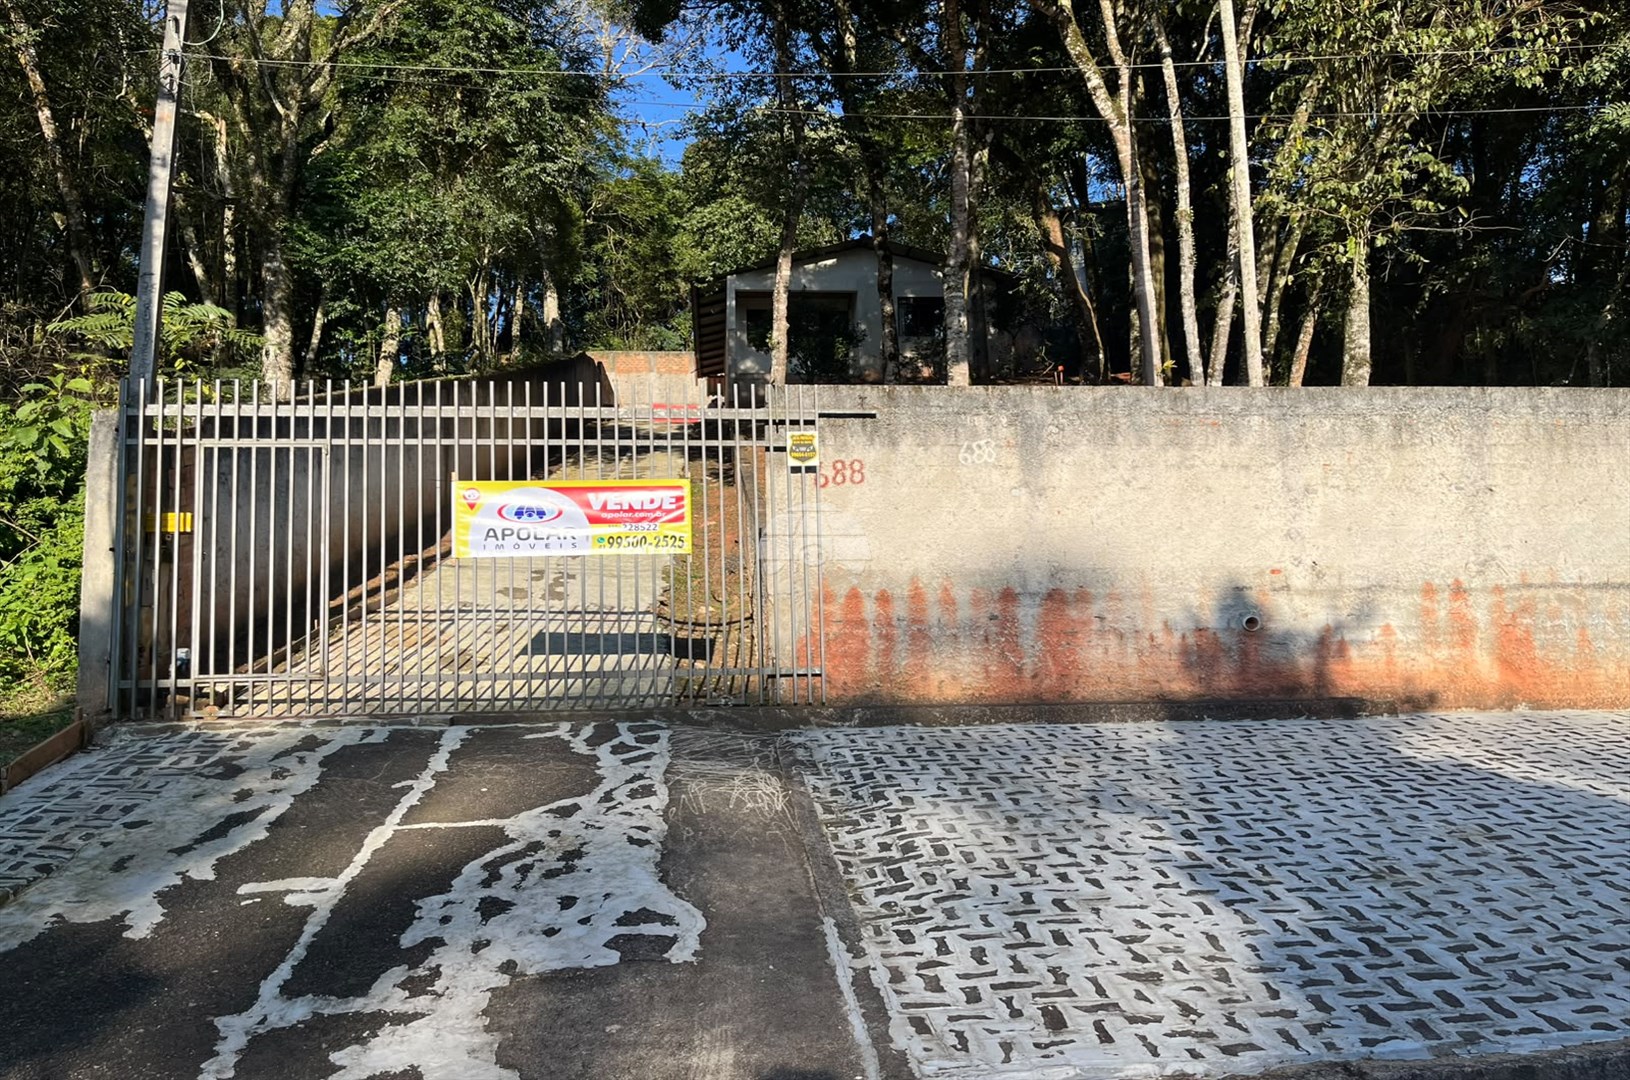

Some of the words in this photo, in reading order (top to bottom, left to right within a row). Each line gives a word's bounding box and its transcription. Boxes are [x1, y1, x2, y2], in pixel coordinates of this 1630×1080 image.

[814, 459, 865, 488] 688
[586, 491, 678, 510] VENDE
[601, 511, 666, 519] apolar.com.br
